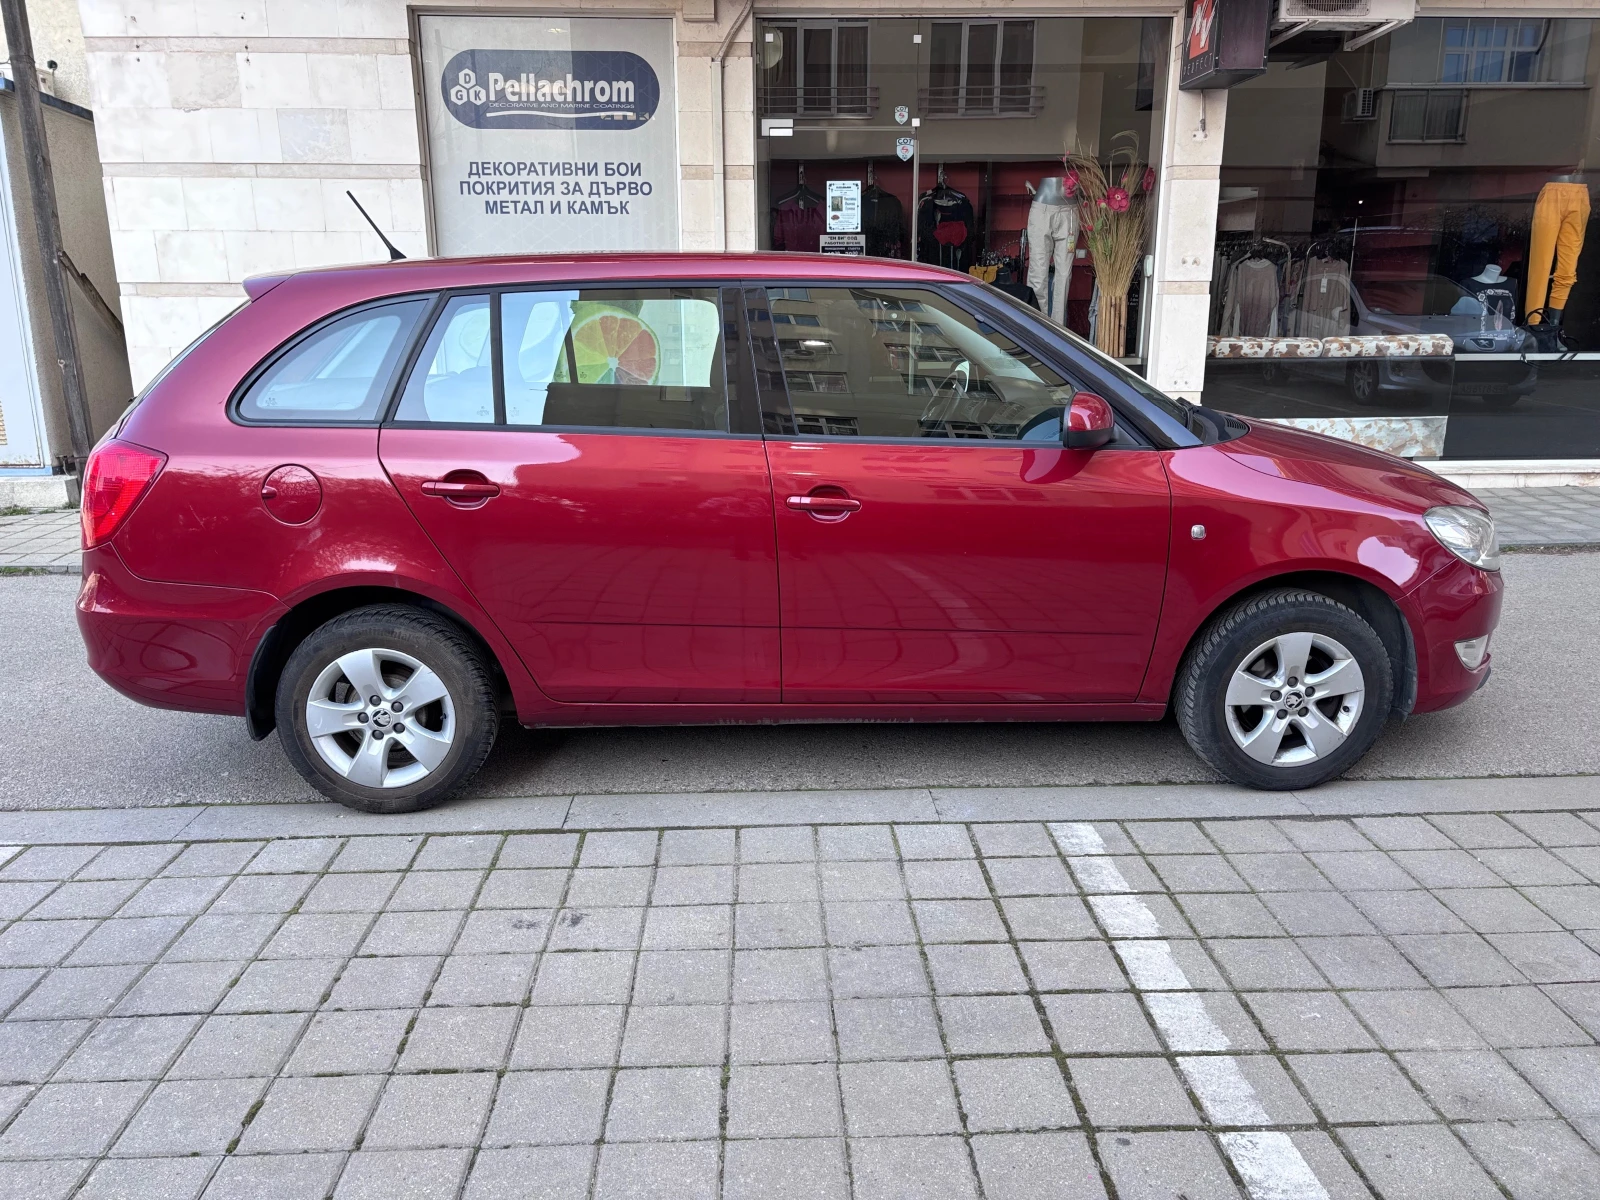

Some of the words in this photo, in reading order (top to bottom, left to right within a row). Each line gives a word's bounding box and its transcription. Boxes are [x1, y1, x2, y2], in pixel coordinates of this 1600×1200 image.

[488, 72, 635, 103] Pellachrom
[468, 161, 599, 178] ДЕКОРАТИВНИ
[604, 162, 642, 177] БОИ
[459, 181, 555, 196] ПОКРИТИЯ
[560, 181, 584, 196] ЗА
[588, 181, 653, 199] ДЪРВО
[484, 200, 544, 215] МЕТАЛ
[550, 201, 562, 215] И
[567, 201, 630, 215] КАМЪК
